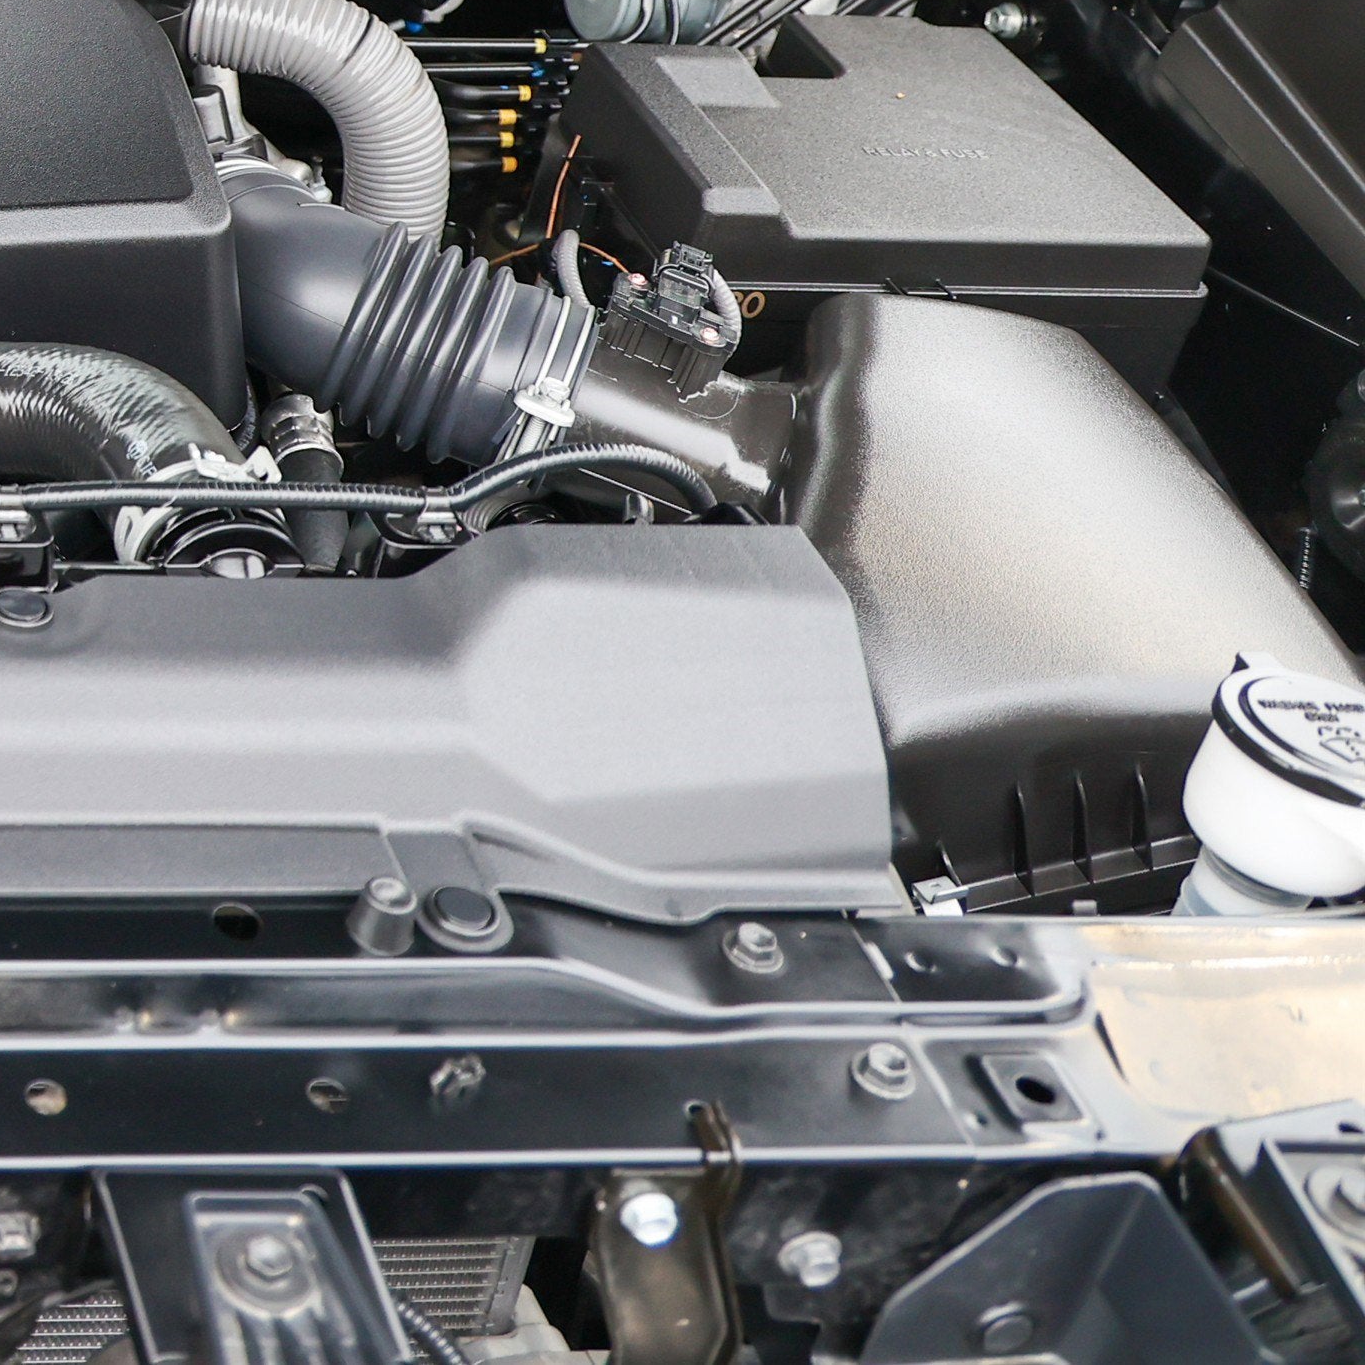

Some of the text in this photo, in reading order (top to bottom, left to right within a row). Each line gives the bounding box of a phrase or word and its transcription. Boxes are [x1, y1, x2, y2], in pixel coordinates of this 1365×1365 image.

[862, 147, 920, 157] RELAY
[939, 148, 989, 159] FUSE
[732, 291, 766, 319] 0
